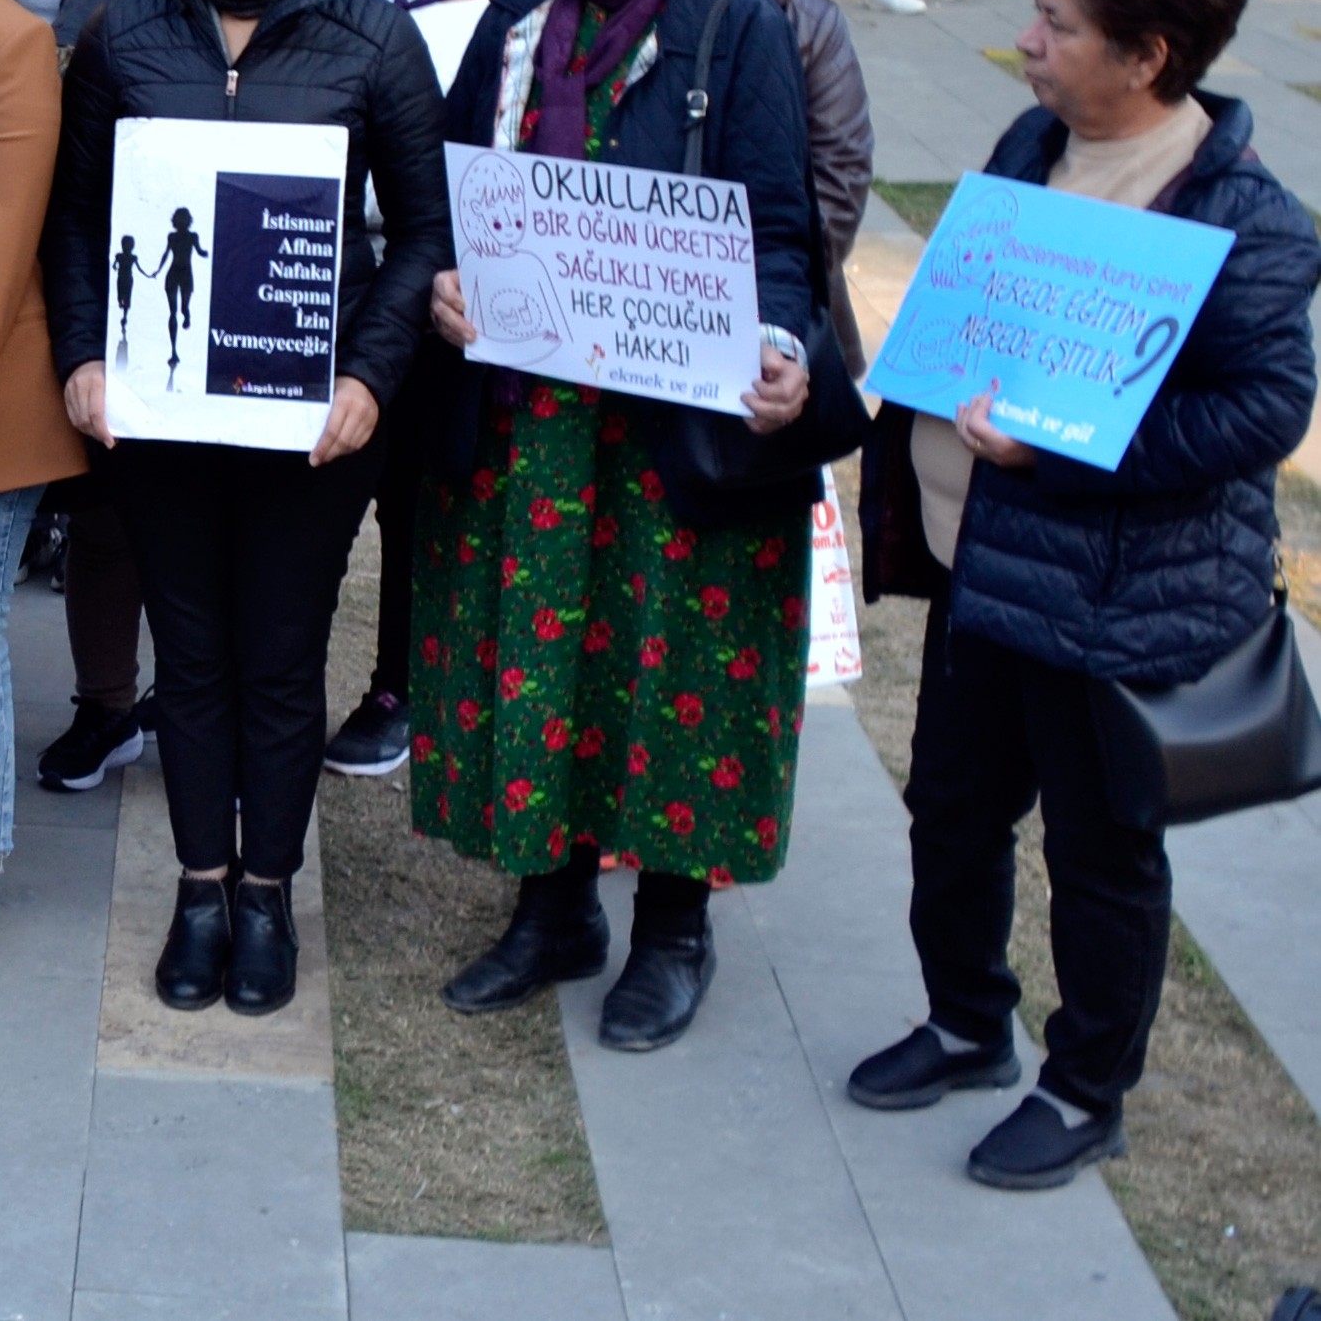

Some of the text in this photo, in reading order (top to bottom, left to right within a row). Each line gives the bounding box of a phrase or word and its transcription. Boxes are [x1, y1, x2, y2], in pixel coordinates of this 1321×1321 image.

[531, 160, 746, 228] OKULLARDA
[262, 208, 335, 233] İstismar
[532, 209, 751, 264] BİR ÖĞÜN ÜCRETSİZ
[278, 237, 333, 257] Affına
[268, 260, 332, 281] Nafaka
[556, 250, 733, 302] SAĞLIKLI YEMEK
[257, 284, 331, 308] Gaspına
[983, 270, 1066, 317] NEREDE
[295, 307, 330, 330] İzin
[571, 289, 732, 337] HER ÇOCUĞUN
[211, 329, 330, 357] Vermeyeceğiz
[615, 331, 690, 368] HAKKI!
[959, 312, 1041, 361] NEREDE
[1113, 316, 1180, 398] ?
[609, 367, 720, 401] ekmek ve gül
